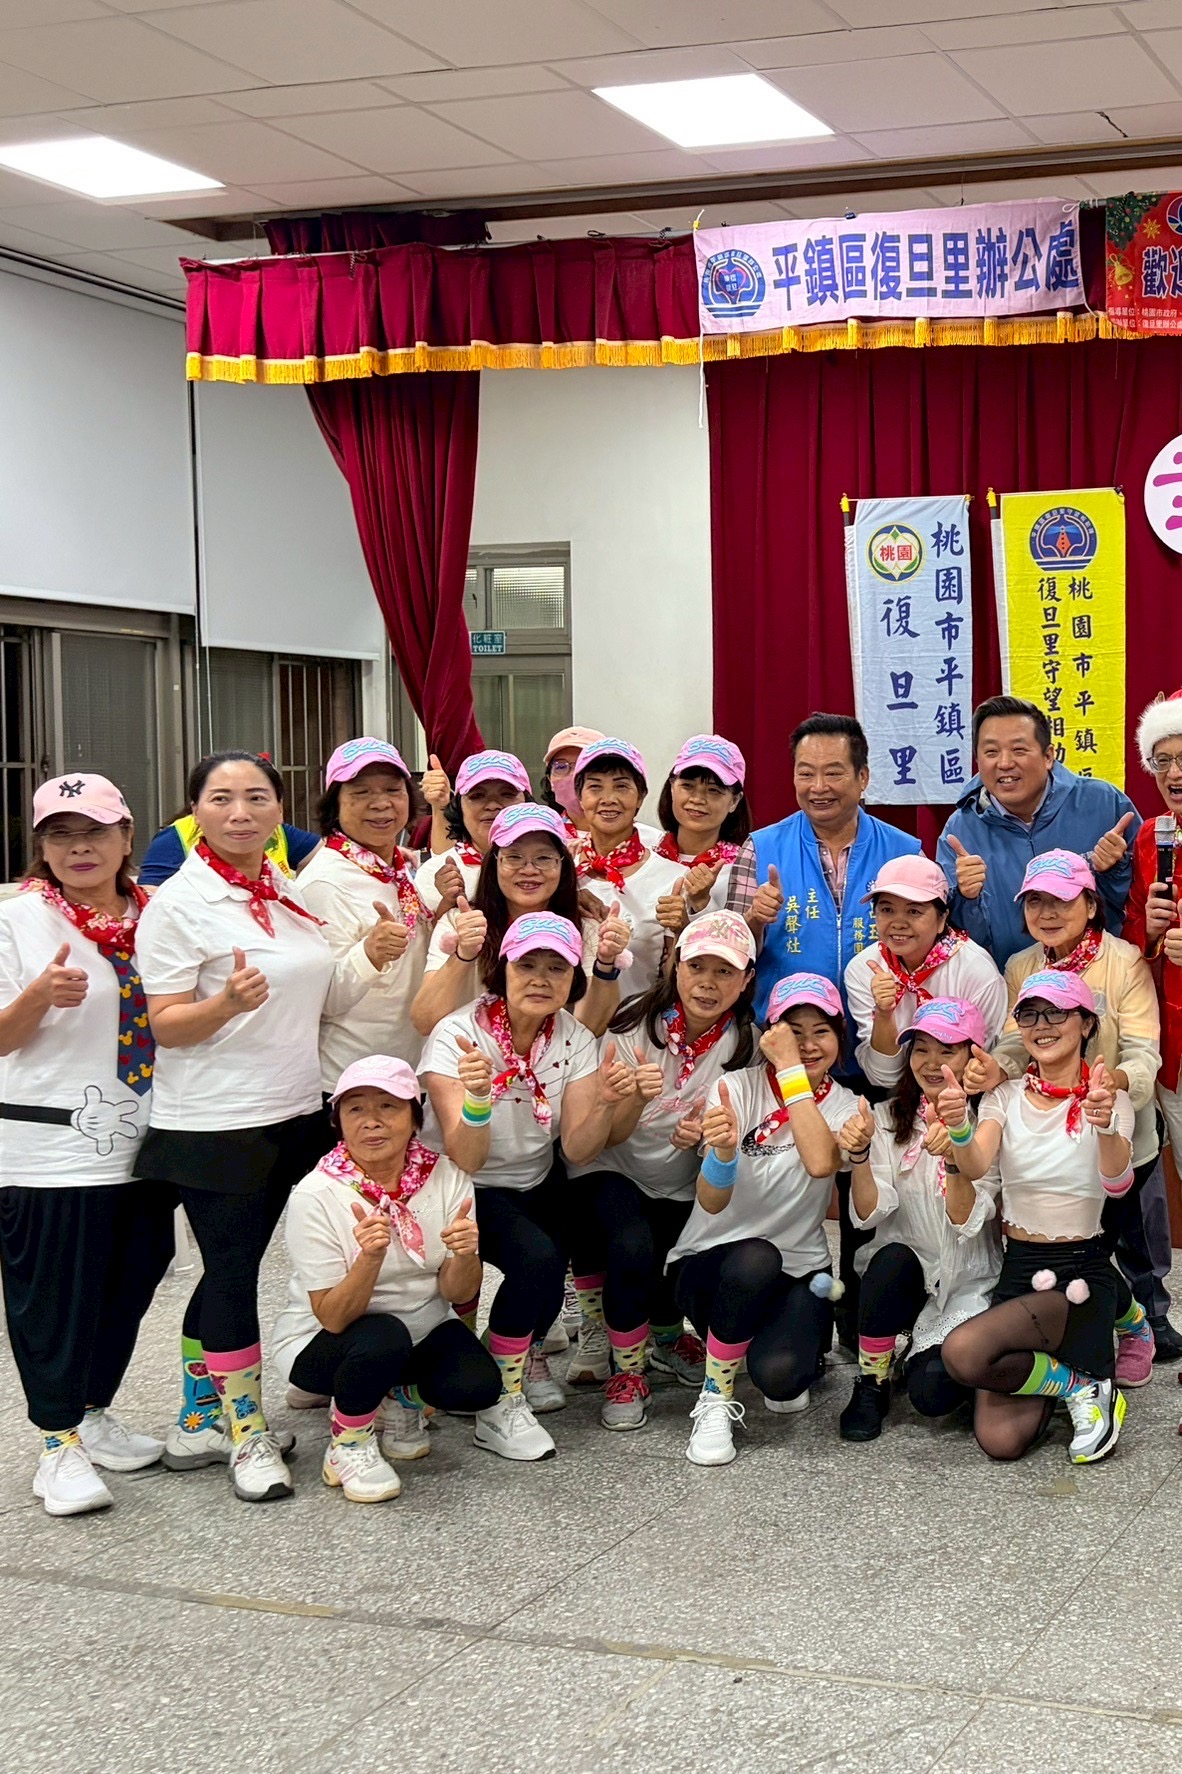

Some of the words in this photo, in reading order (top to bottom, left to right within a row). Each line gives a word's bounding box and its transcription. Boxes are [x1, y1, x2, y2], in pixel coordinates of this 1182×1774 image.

[772, 220, 1080, 311] 平鎮區復旦里辦公處
[879, 544, 913, 562] 桃園
[930, 520, 966, 785] 桃園市平鎮區
[880, 595, 921, 785] 復旦里
[58, 780, 86, 798] NY
[805, 887, 820, 919] 主任
